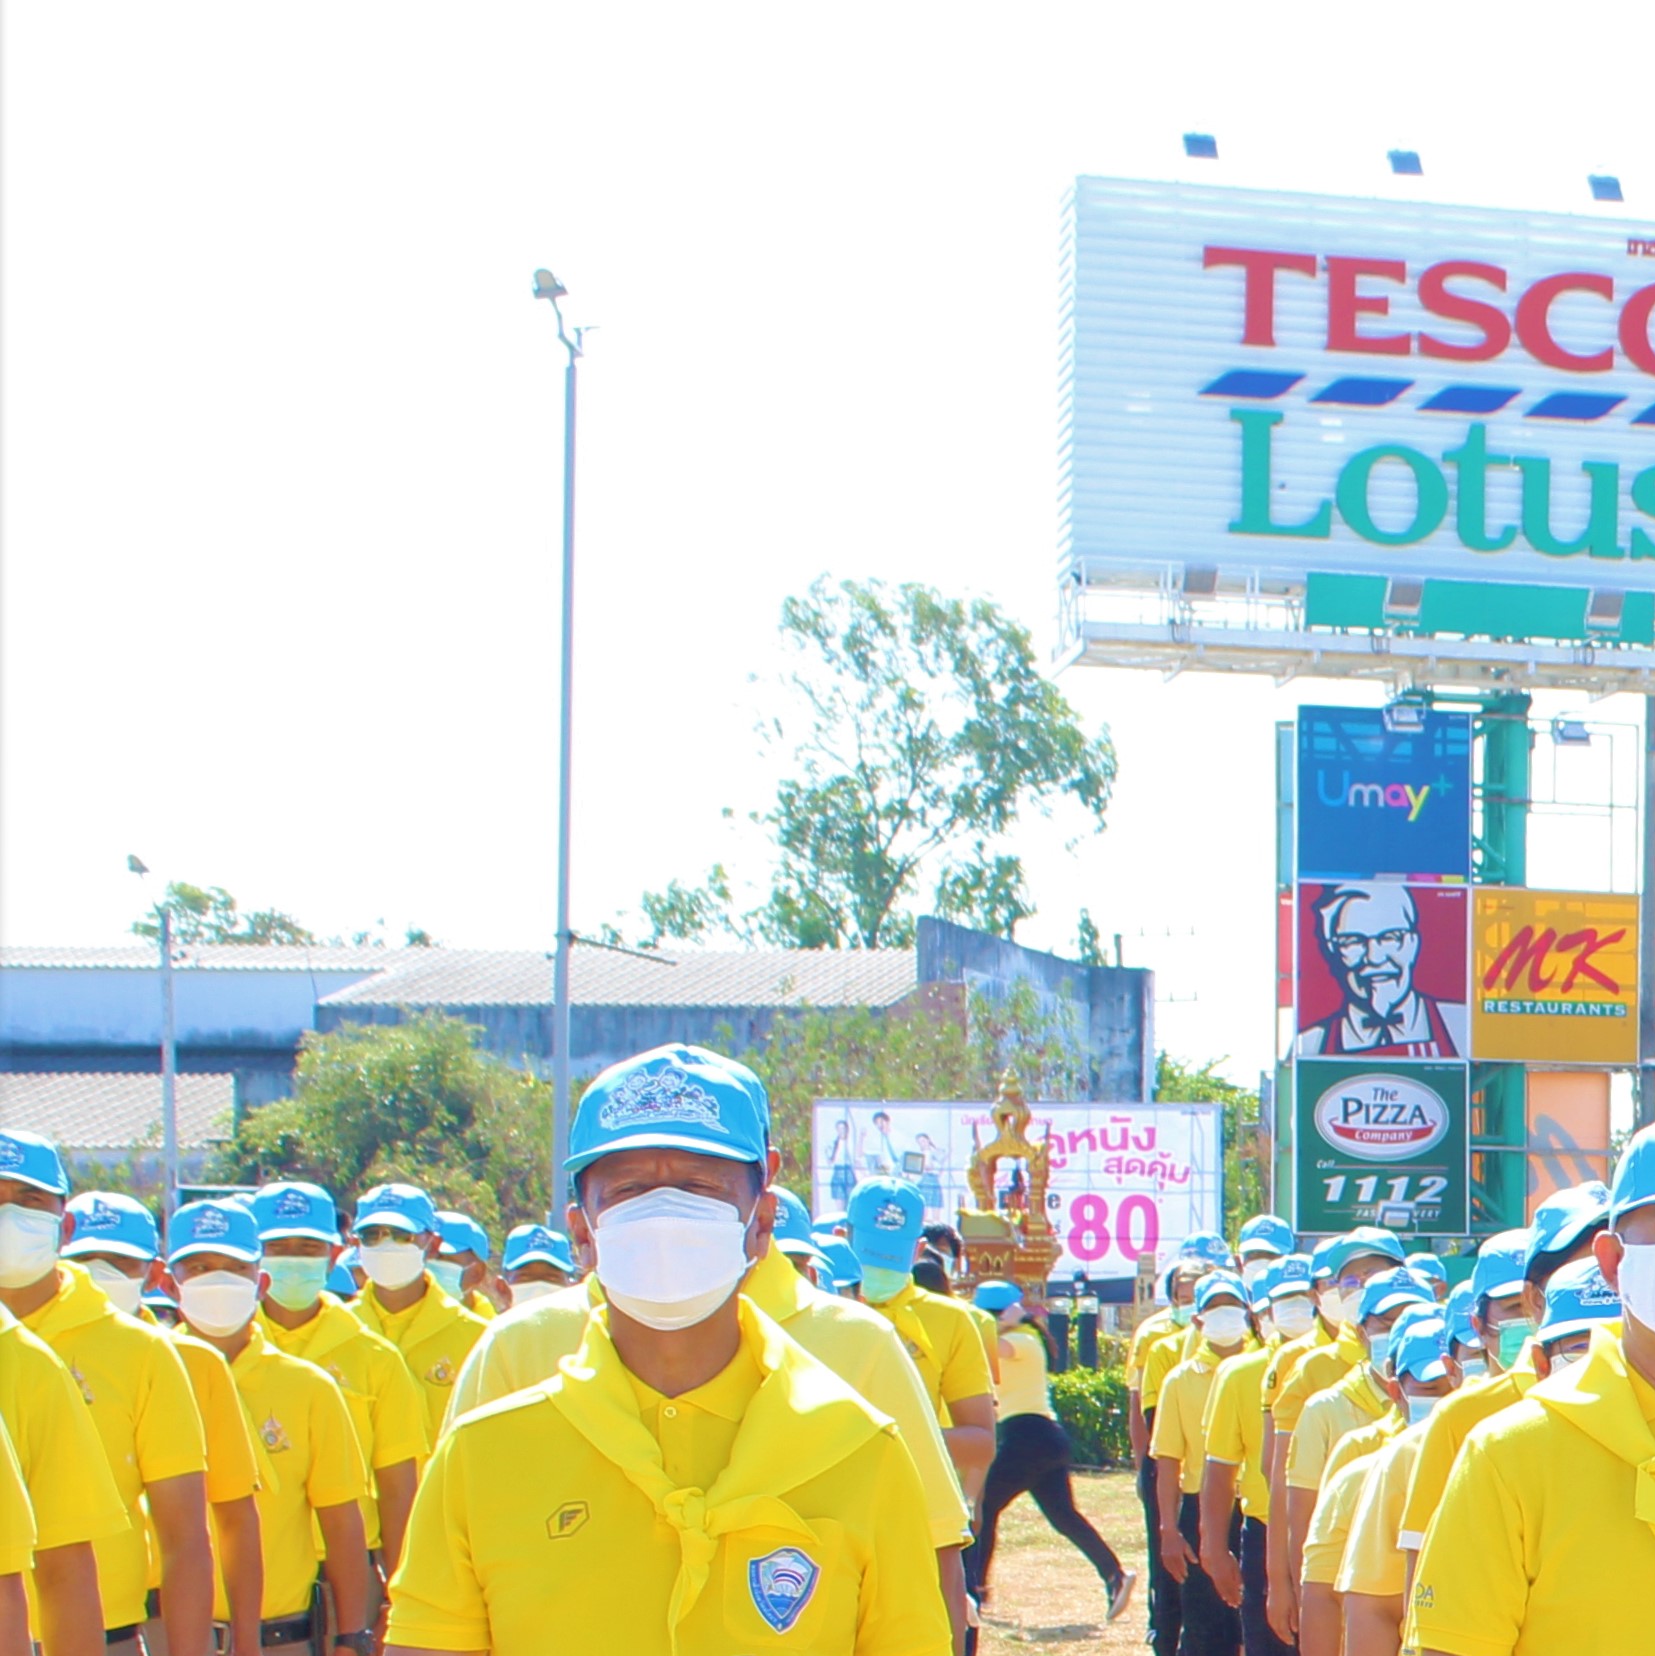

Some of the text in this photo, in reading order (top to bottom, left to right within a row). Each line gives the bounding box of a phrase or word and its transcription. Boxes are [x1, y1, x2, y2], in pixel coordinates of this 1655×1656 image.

[1483, 925, 1627, 996] MK
[1483, 1000, 1626, 1016] RESTAURANTS
[1372, 1087, 1399, 1101] The
[1341, 1096, 1427, 1125] PIZZA
[1355, 1129, 1413, 1142] Company
[1316, 1160, 1335, 1169] Call
[1322, 1175, 1448, 1203] 1112
[1355, 1207, 1378, 1218] FAS
[1067, 1193, 1160, 1262] 80
